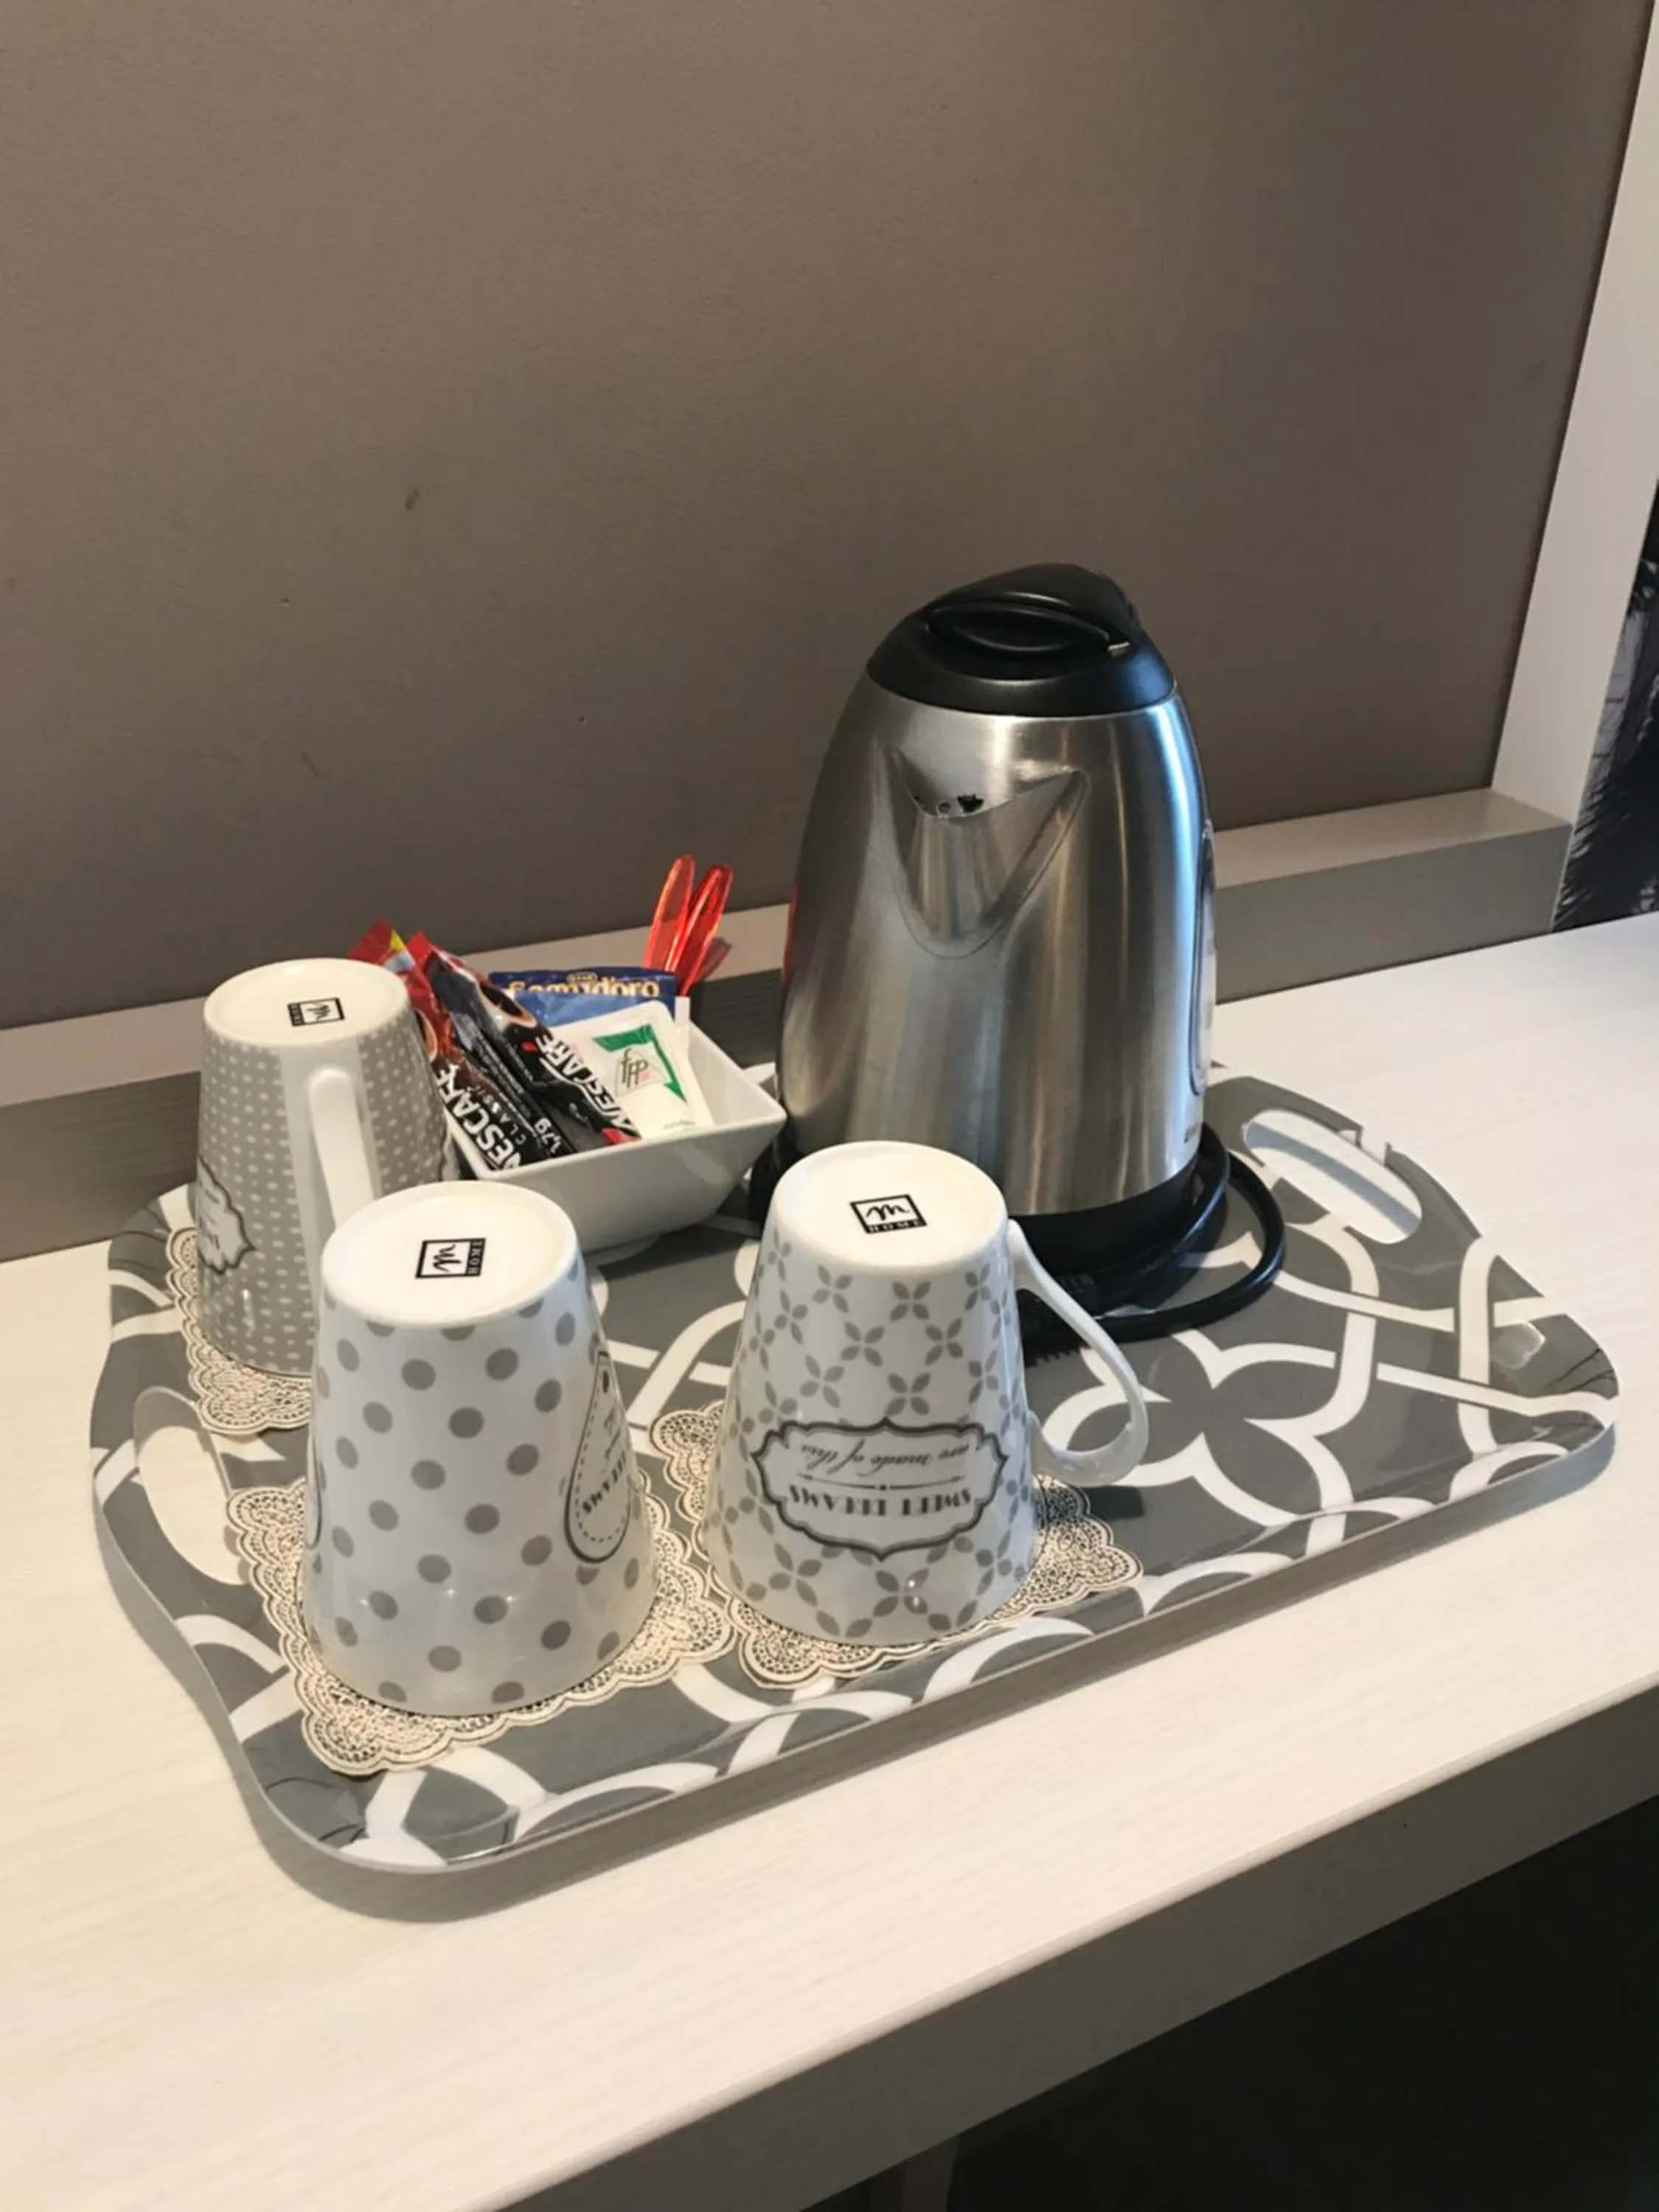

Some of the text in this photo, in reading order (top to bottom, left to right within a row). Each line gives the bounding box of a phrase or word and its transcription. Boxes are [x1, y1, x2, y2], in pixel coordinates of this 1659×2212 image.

[800, 1439, 970, 1476] are made of this
[900, 1487, 972, 1517] SWEET
